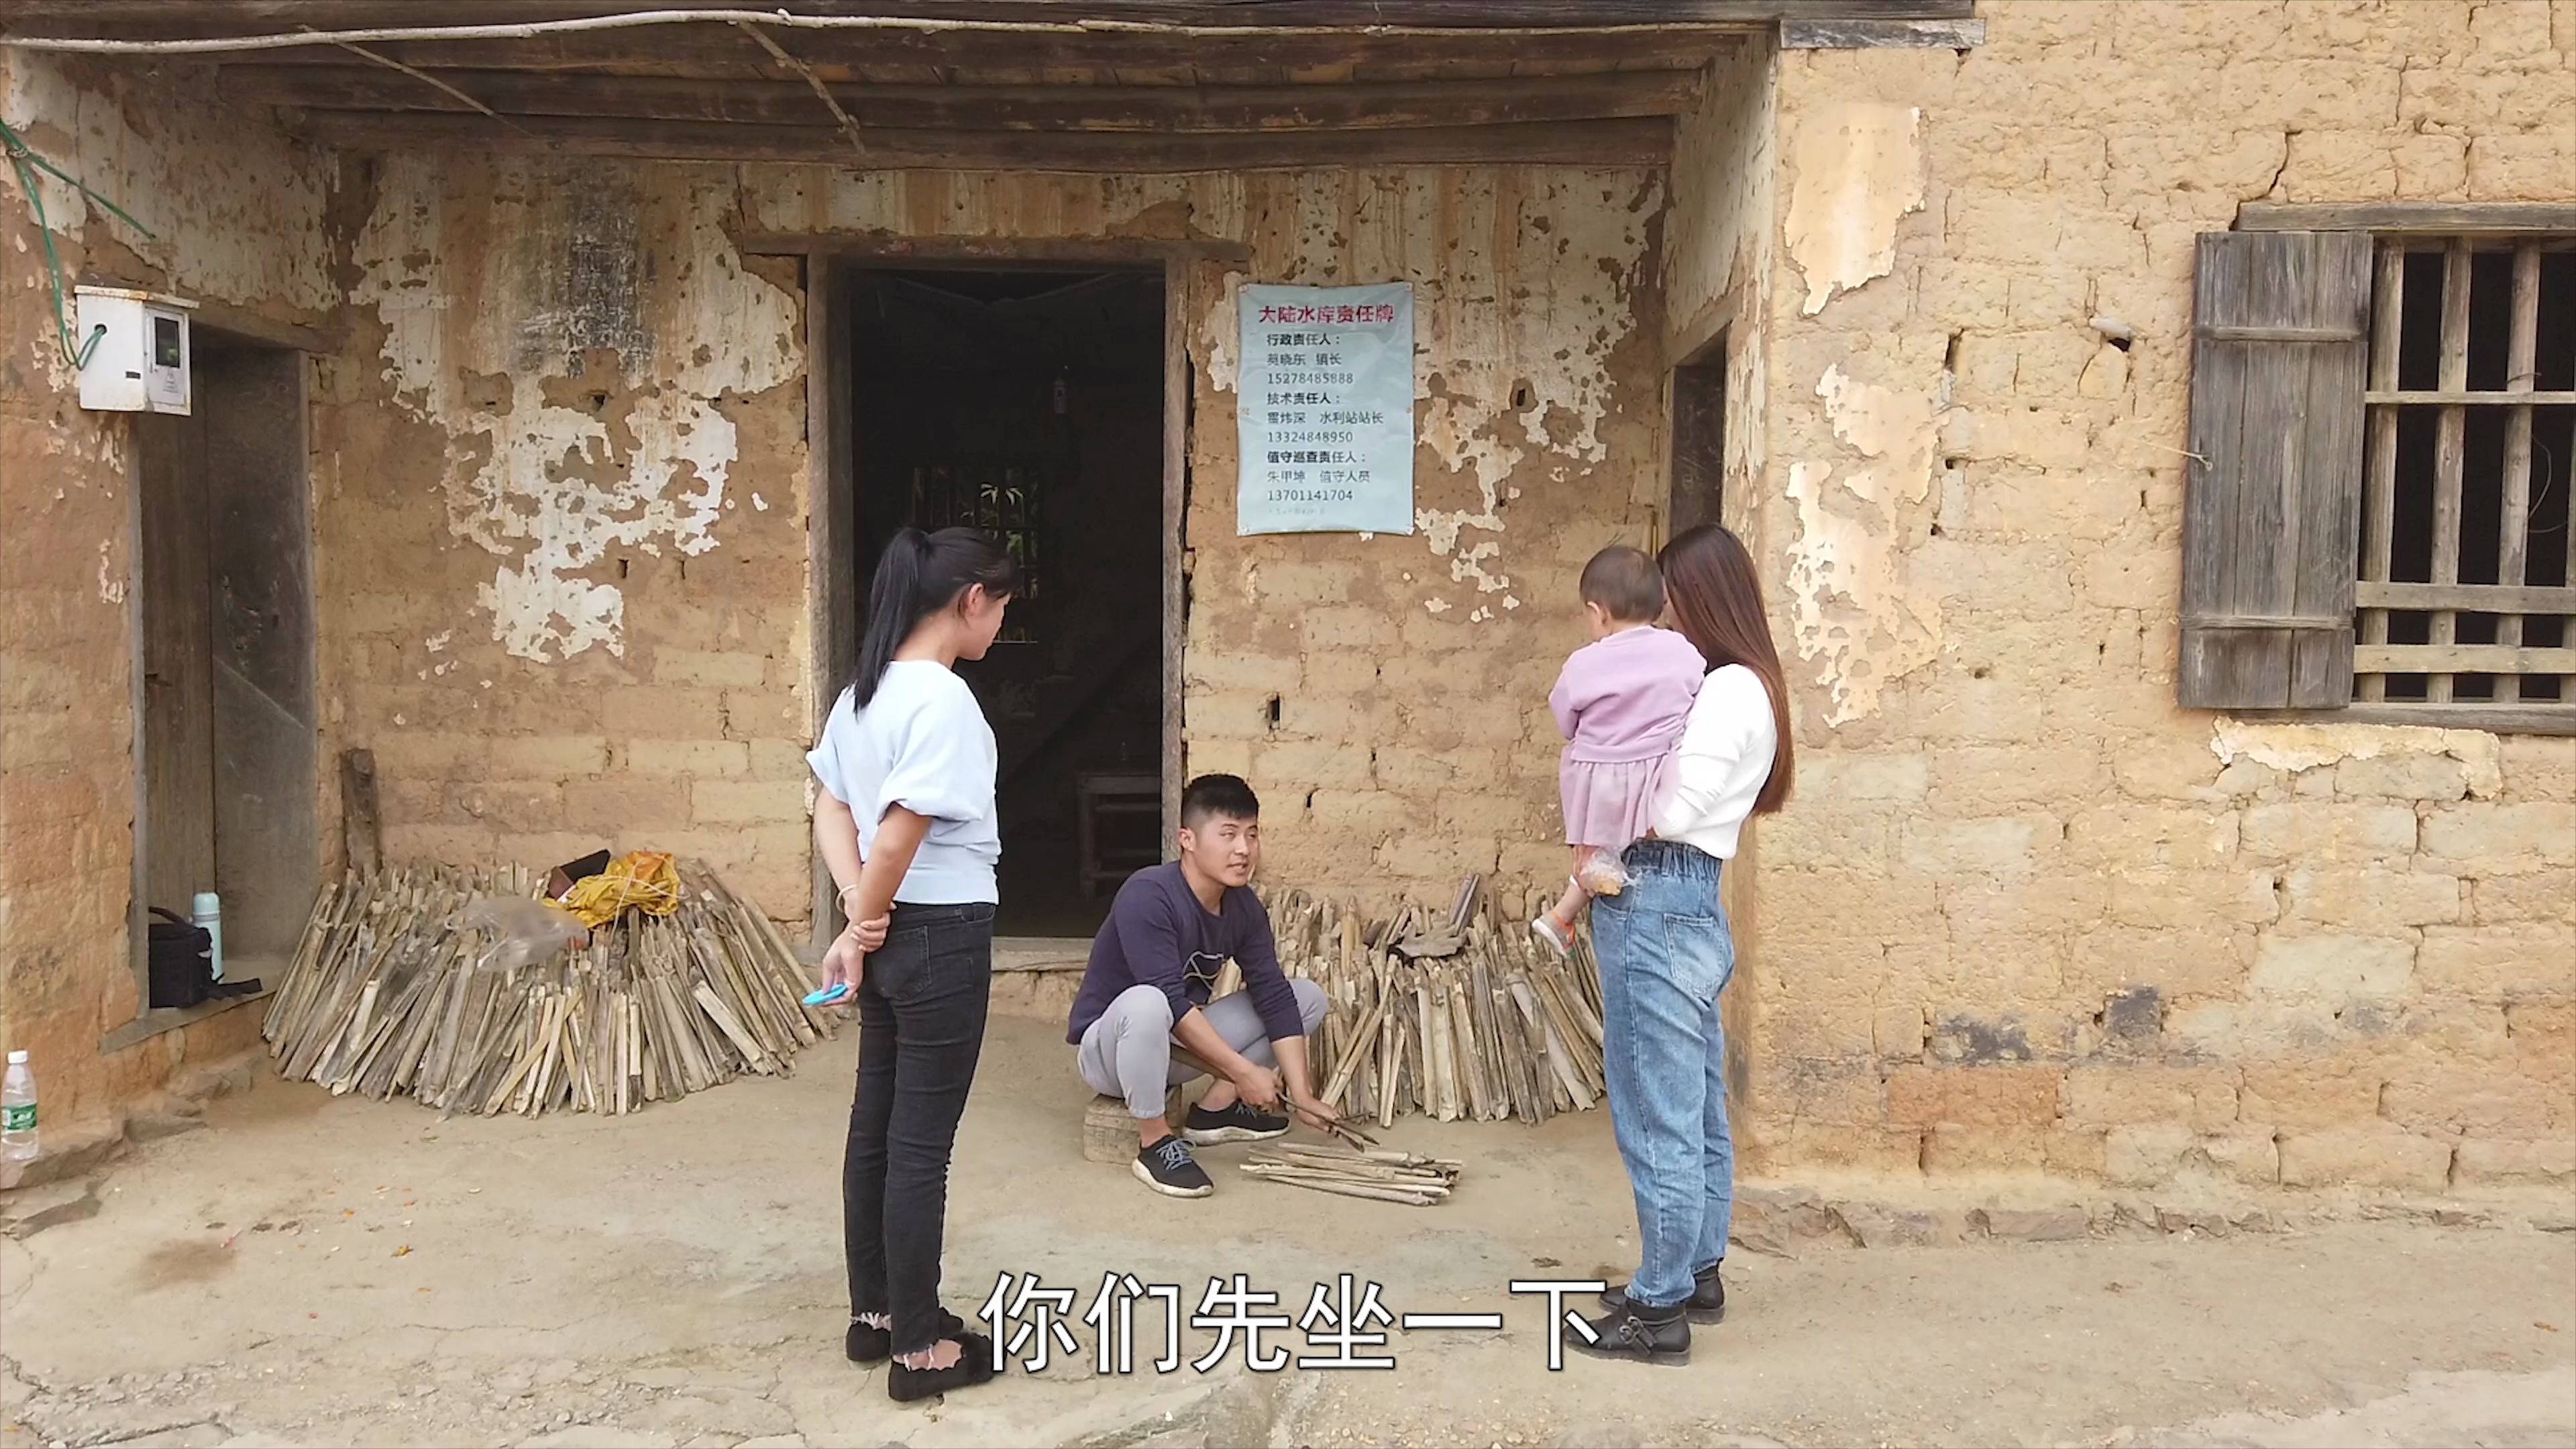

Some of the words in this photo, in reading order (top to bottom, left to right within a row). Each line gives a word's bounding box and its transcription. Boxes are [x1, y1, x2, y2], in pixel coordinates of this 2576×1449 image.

[1258, 305, 1394, 323] 大陆水库责任牌
[1316, 353, 1342, 366] 镇长
[1267, 372, 1354, 384] 15278485888
[1319, 412, 1384, 425] 水利站站长
[1267, 431, 1354, 443] 13324848950
[1319, 470, 1371, 483] 值守人员
[1267, 490, 1354, 501] 13701141704
